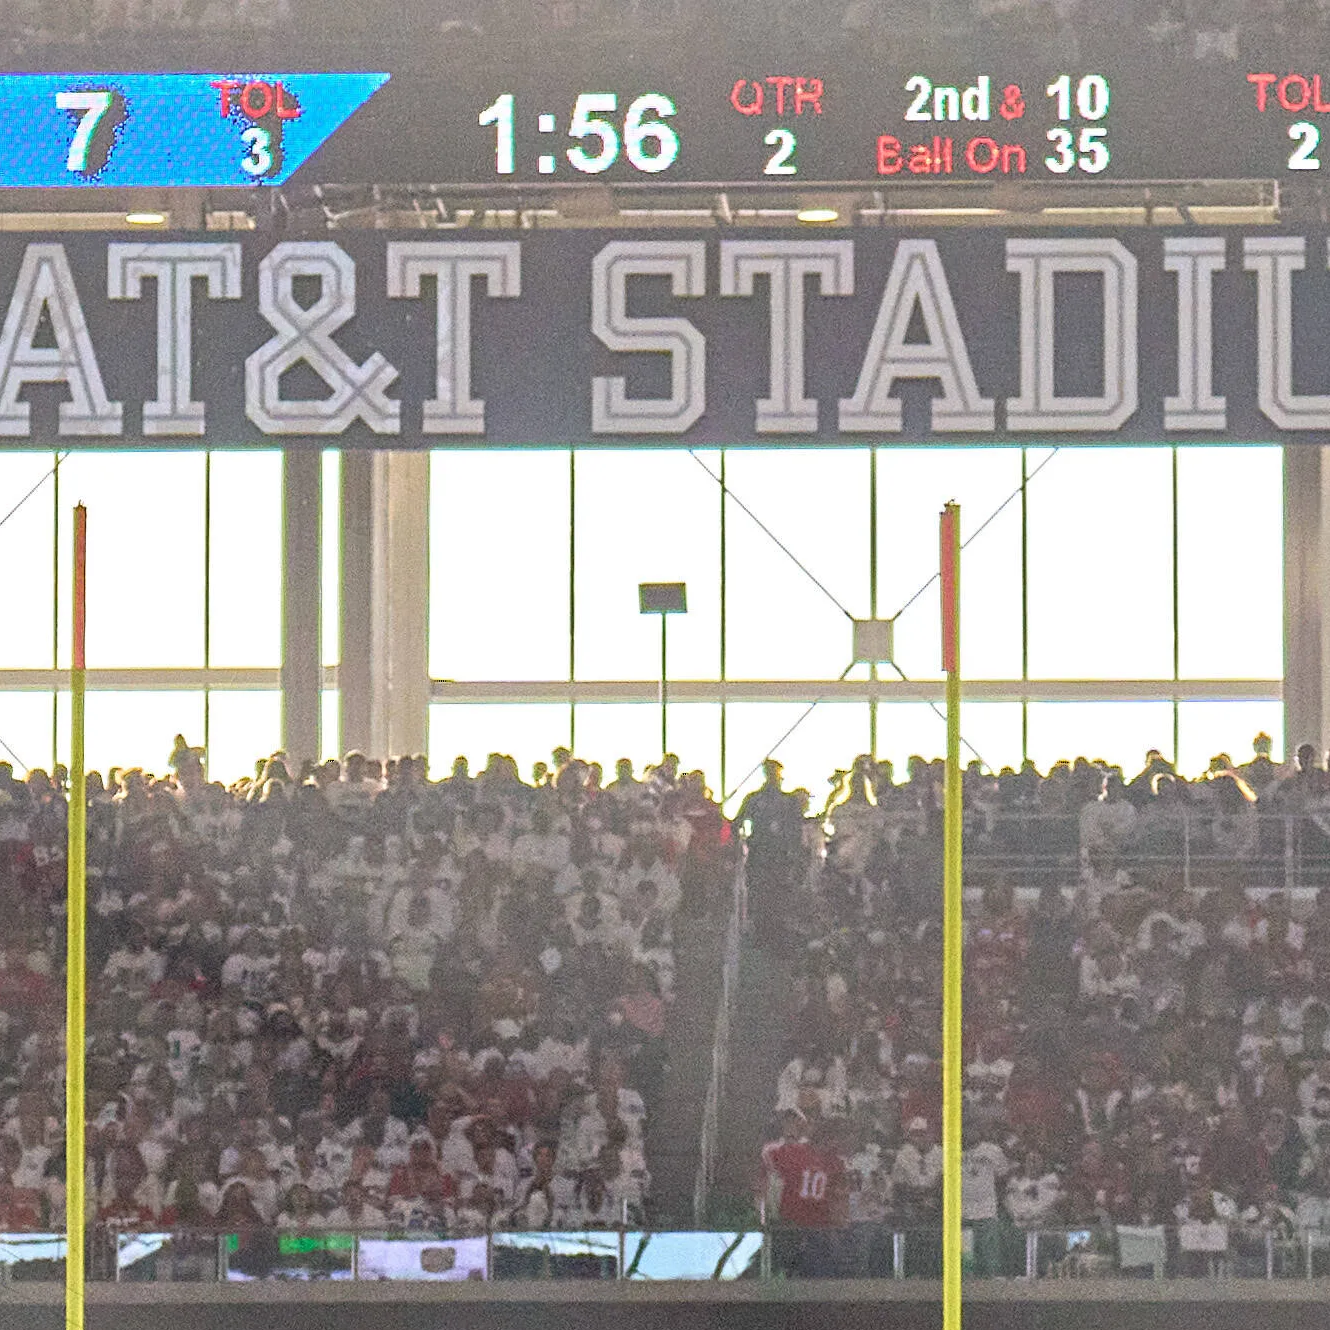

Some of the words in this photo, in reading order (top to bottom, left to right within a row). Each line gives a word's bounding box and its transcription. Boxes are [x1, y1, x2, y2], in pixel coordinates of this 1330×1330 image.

[212, 80, 300, 119] TOL
[731, 76, 824, 116] QTR
[905, 75, 990, 122] 2nd
[999, 84, 1025, 121] &
[1045, 74, 1110, 122] 10
[55, 91, 112, 171] 7
[241, 128, 272, 175] 3
[478, 92, 679, 174] 1:56
[763, 128, 798, 175] 2
[876, 134, 953, 175] Ball
[968, 136, 1027, 174] On
[1044, 127, 1110, 174] 35
[1287, 121, 1321, 171] 2
[800, 1168, 827, 1199] 10
